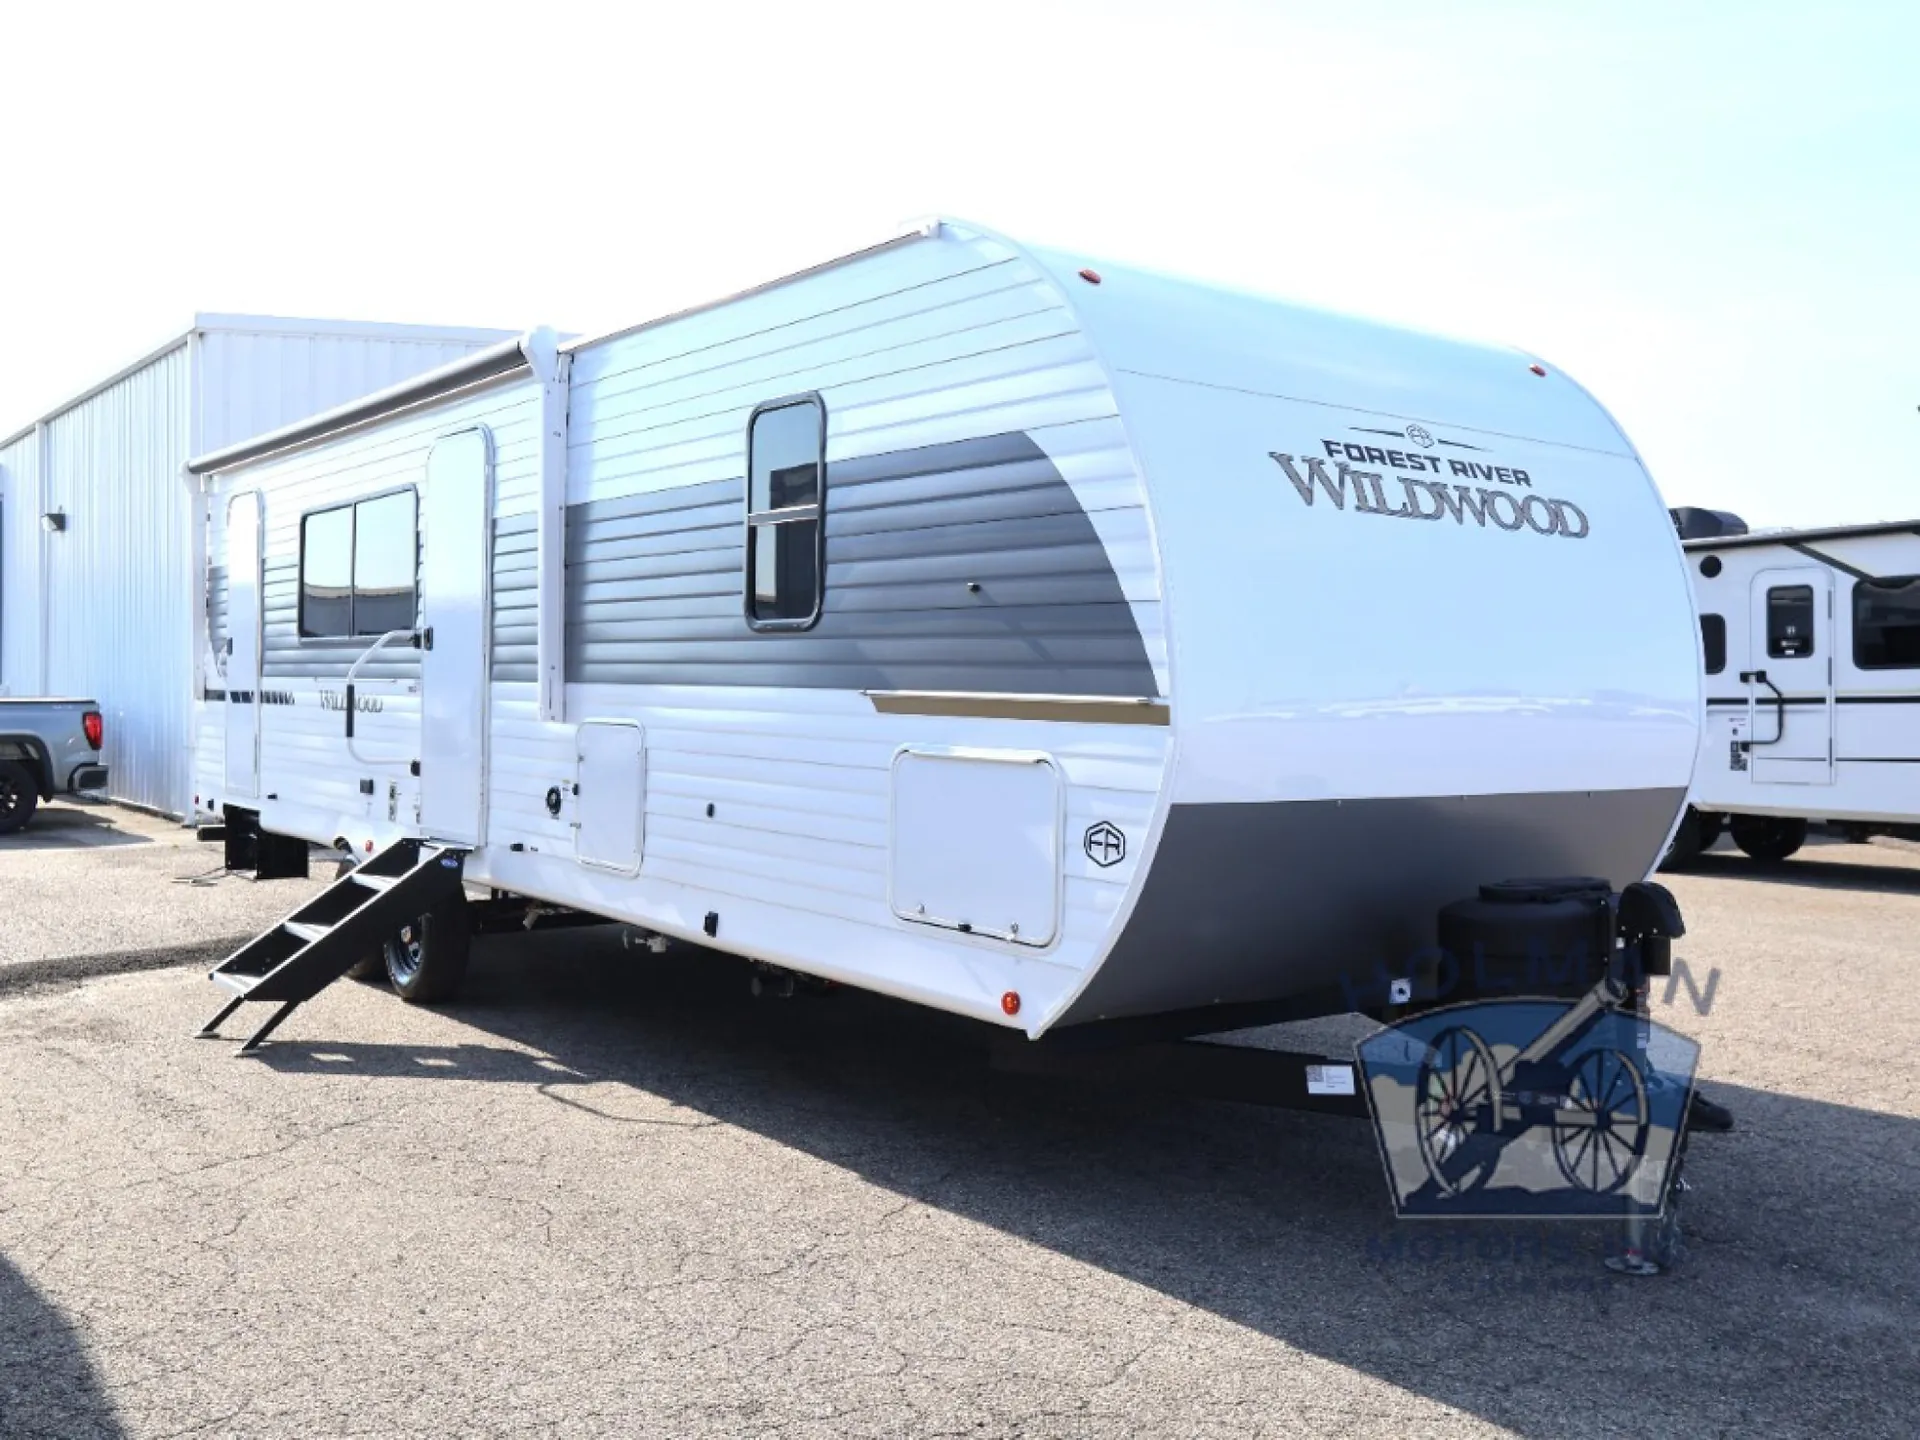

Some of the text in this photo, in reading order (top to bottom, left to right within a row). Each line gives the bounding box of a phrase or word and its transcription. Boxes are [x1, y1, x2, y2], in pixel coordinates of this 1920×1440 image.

[1267, 451, 1589, 539] WILDWOOD
[1320, 438, 1533, 487] FOREST RIVER
